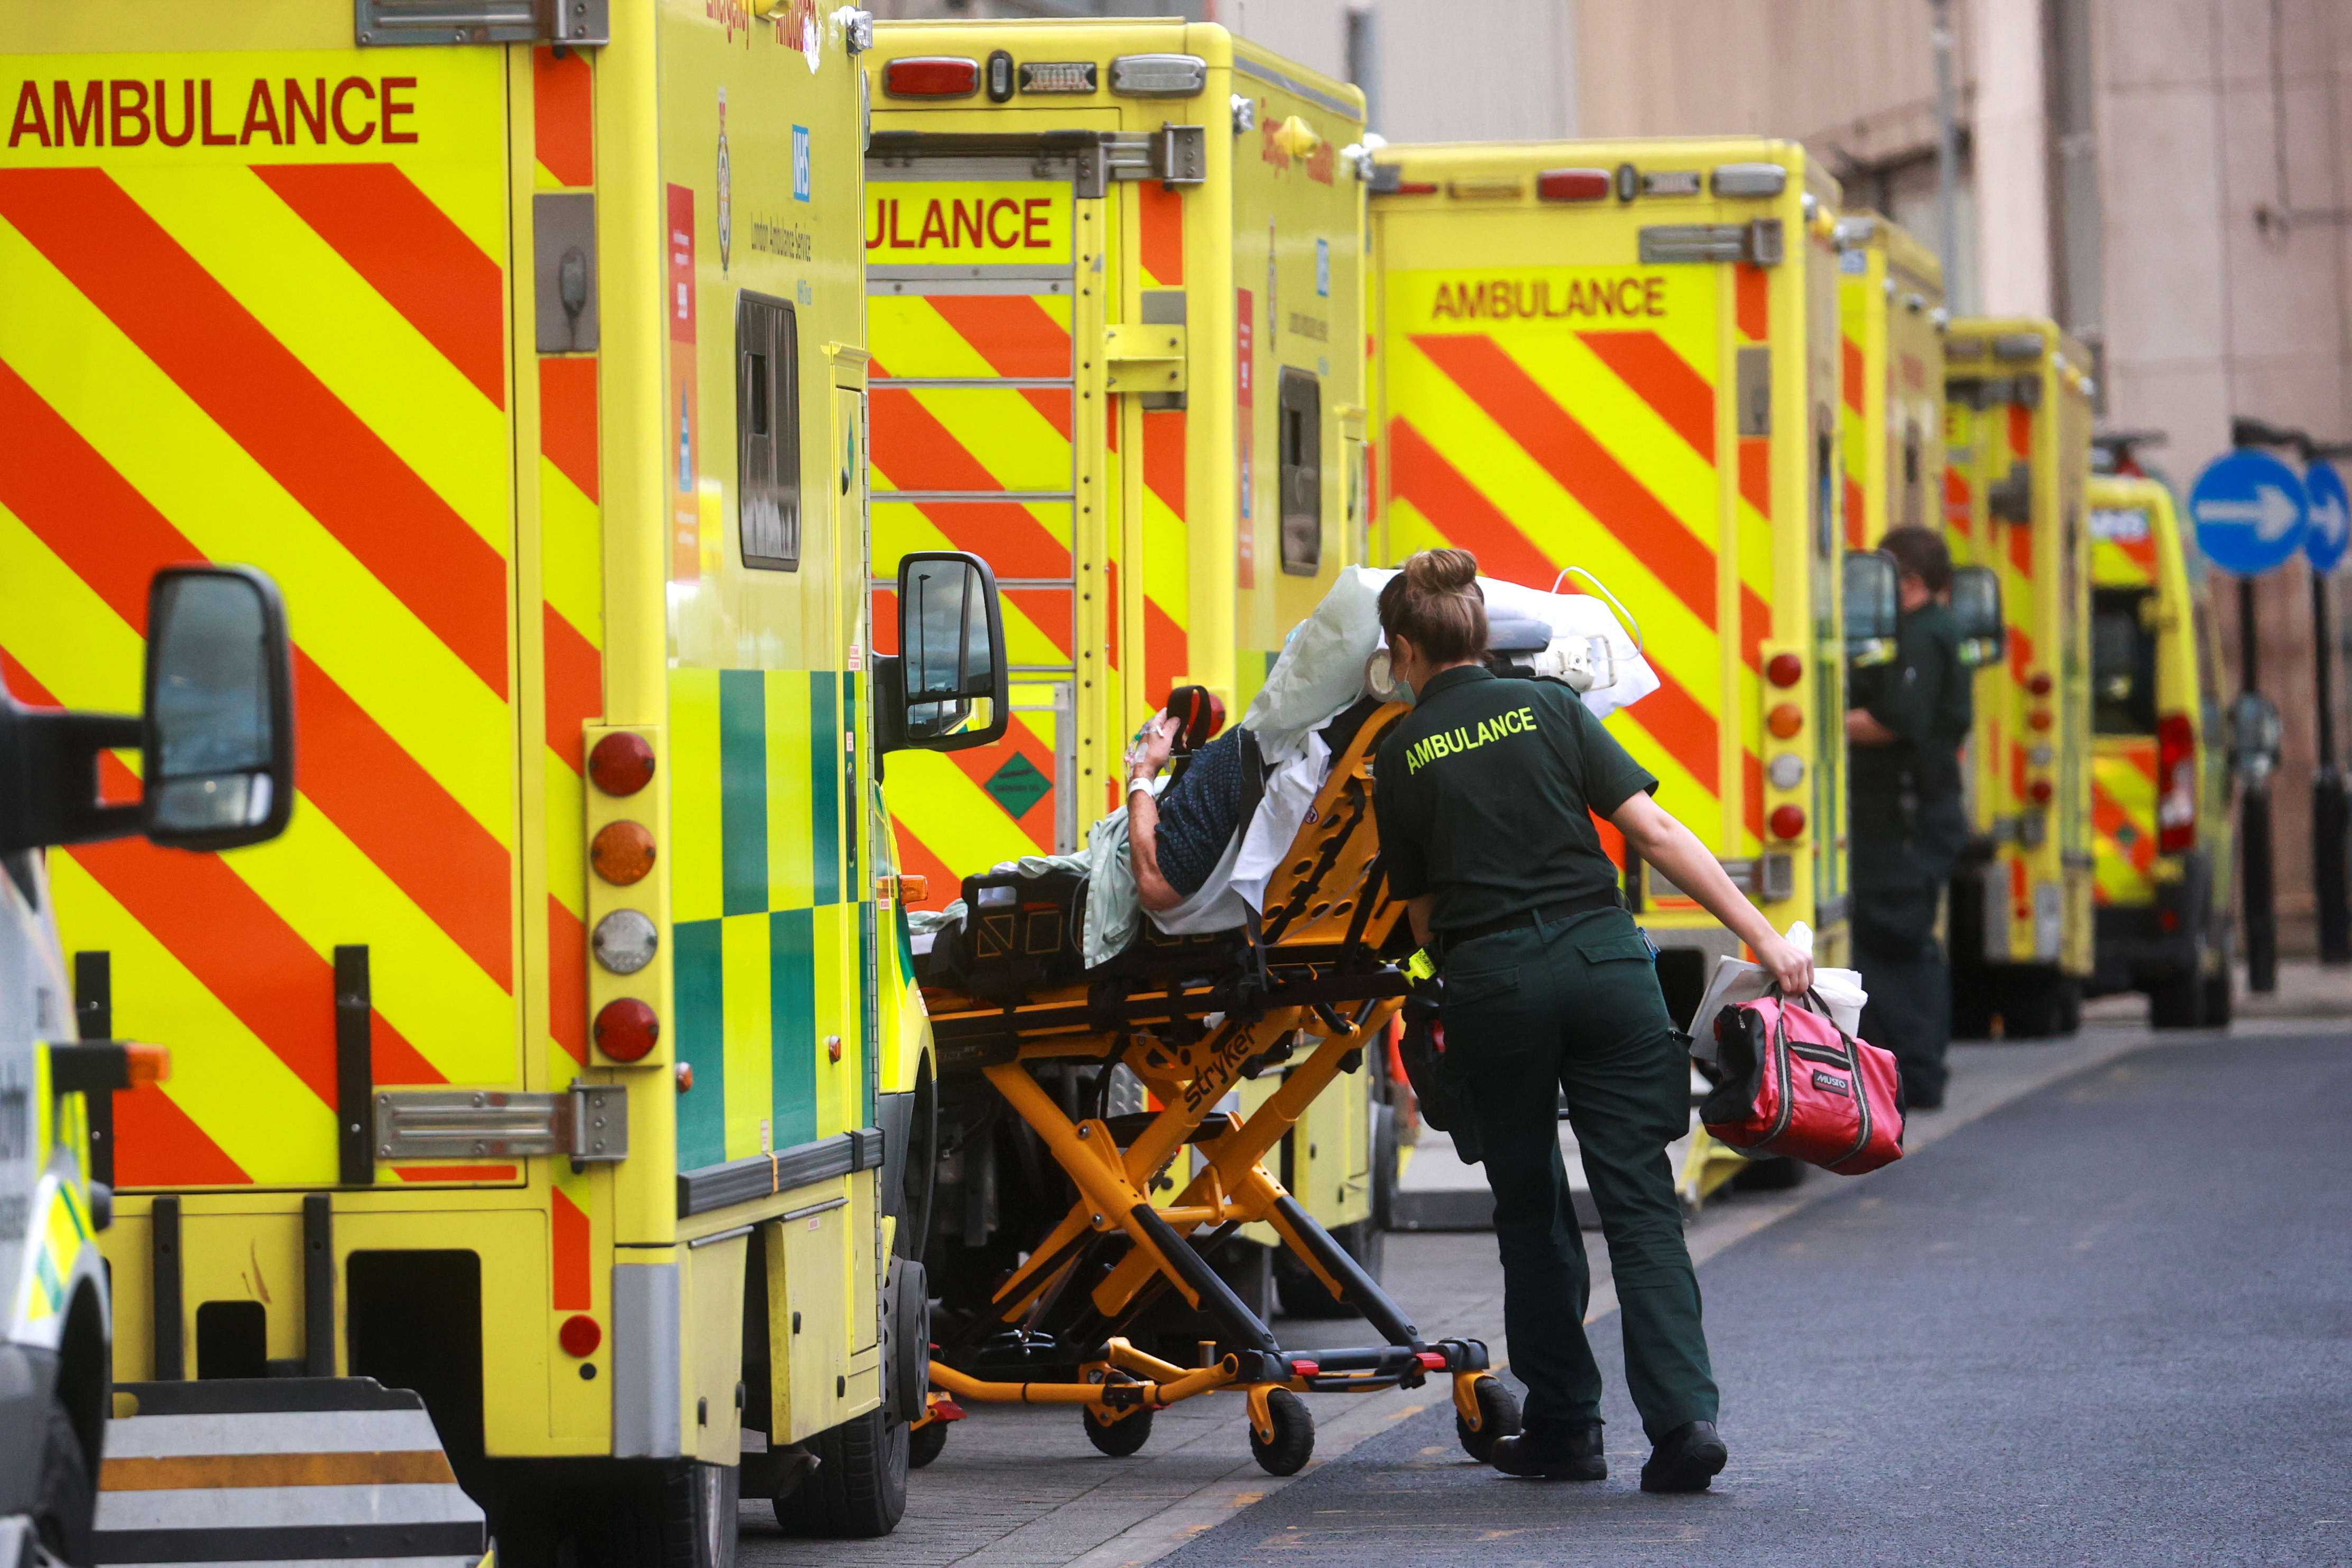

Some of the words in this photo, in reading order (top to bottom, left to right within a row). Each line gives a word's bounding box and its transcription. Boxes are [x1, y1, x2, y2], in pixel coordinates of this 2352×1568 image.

[8, 76, 419, 147] AMBULANCE
[793, 130, 809, 196] NHS
[795, 222, 811, 262] Service
[1432, 276, 1666, 319] AMBULANCE
[1405, 706, 1537, 775] AMBULANCE
[1184, 1022, 1256, 1113] stryker
[1816, 1074, 1846, 1089] MUSTO
